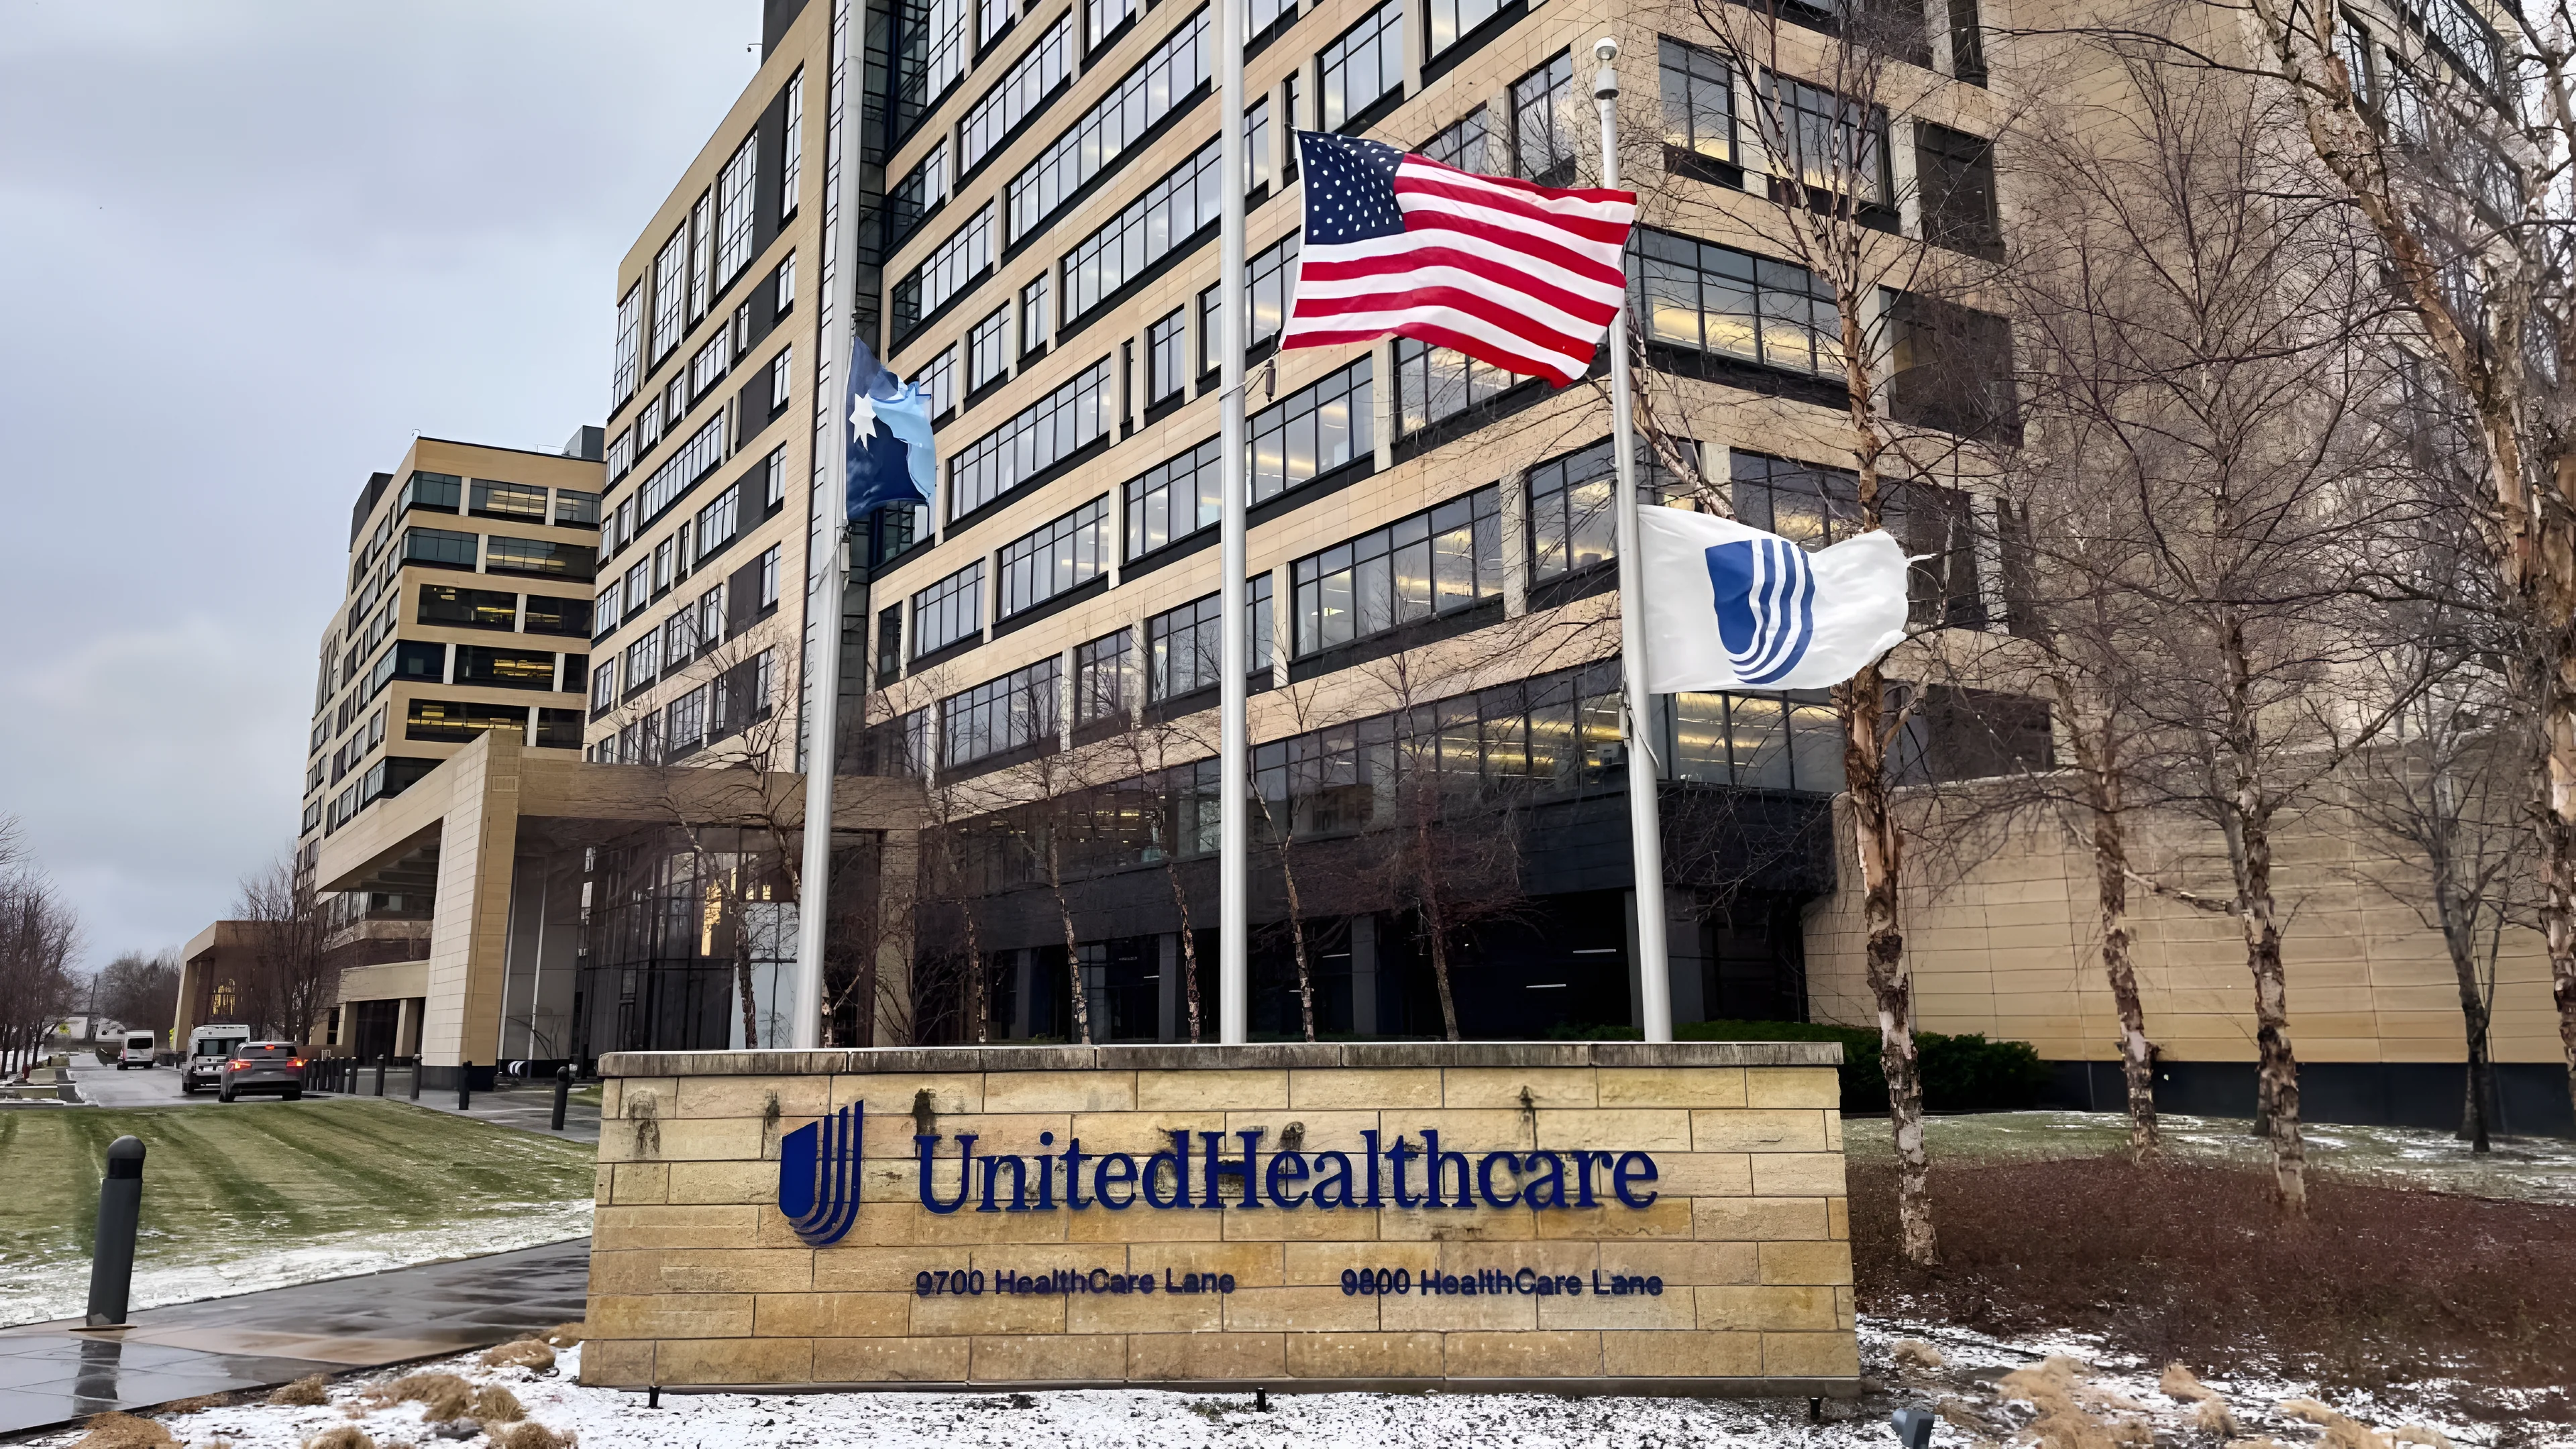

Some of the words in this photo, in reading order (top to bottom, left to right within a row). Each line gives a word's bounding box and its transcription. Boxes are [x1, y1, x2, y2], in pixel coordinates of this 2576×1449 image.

[914, 1128, 1659, 1214] UnitedHealthcare
[916, 1269, 985, 1295] 9700
[996, 1267, 1155, 1295] HealthCare
[1165, 1267, 1235, 1295] Lane
[1341, 1267, 1411, 1296] 9800
[1420, 1267, 1582, 1296] HealthCare
[1592, 1269, 1664, 1296] Lane
